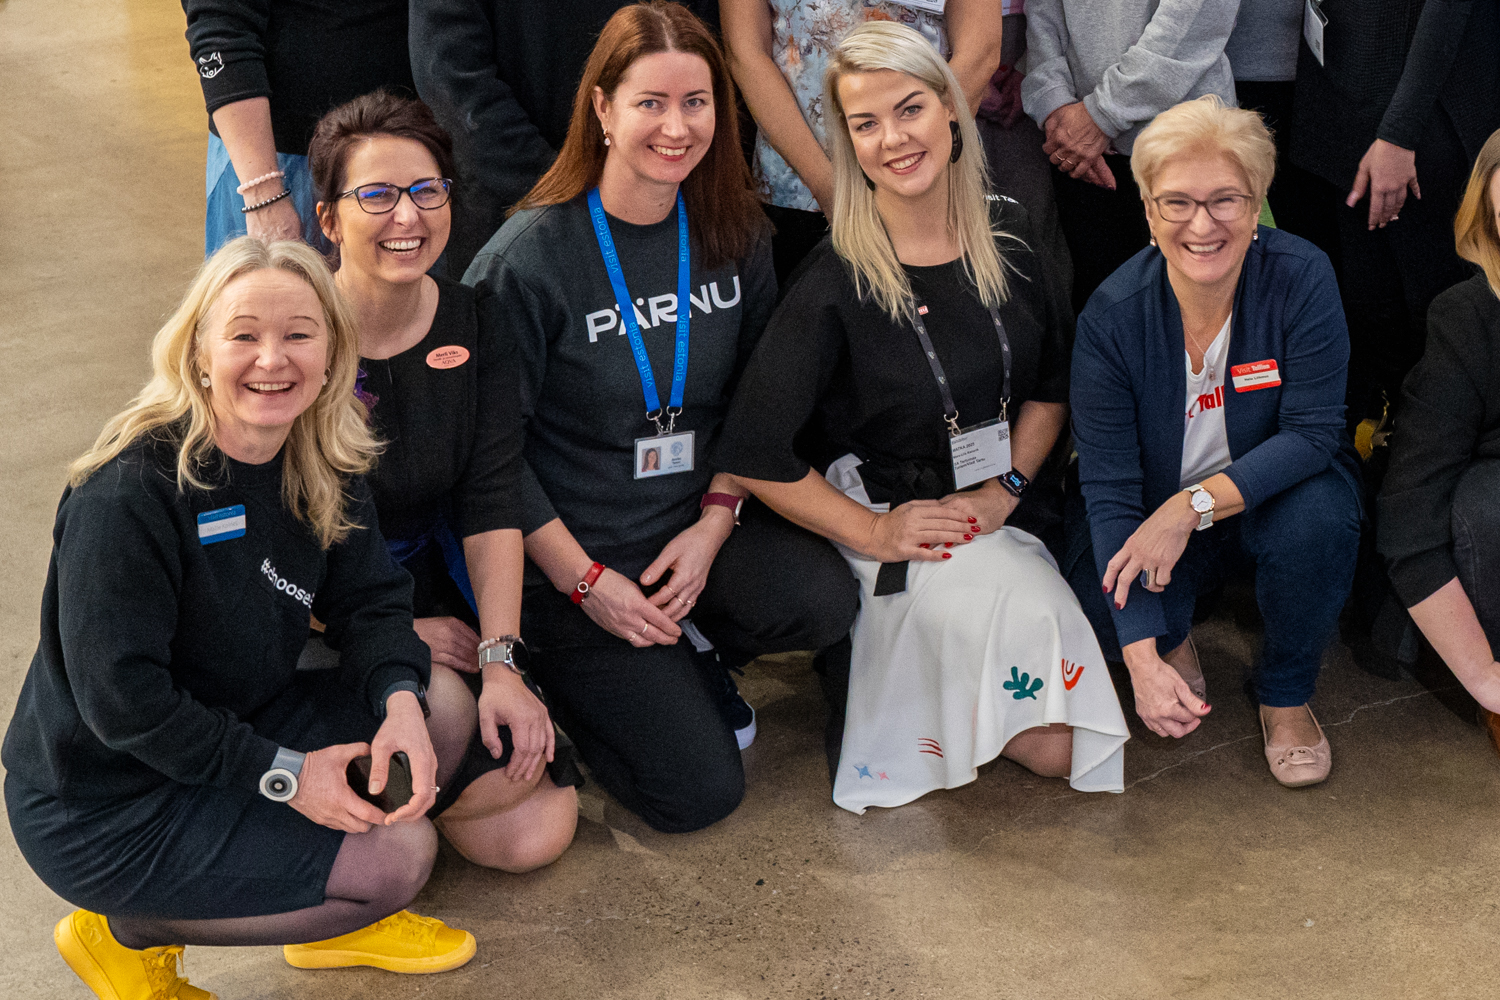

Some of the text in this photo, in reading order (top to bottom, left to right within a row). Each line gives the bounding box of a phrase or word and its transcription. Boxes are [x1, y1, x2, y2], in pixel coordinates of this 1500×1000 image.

[594, 207, 619, 274] visit estonia
[680, 224, 689, 262] estonia
[585, 275, 741, 343] PÄRNU
[629, 321, 653, 388] visit estonia
[676, 314, 687, 382] visit estonia
[1237, 366, 1251, 374] Visit
[260, 557, 316, 609] #choose
